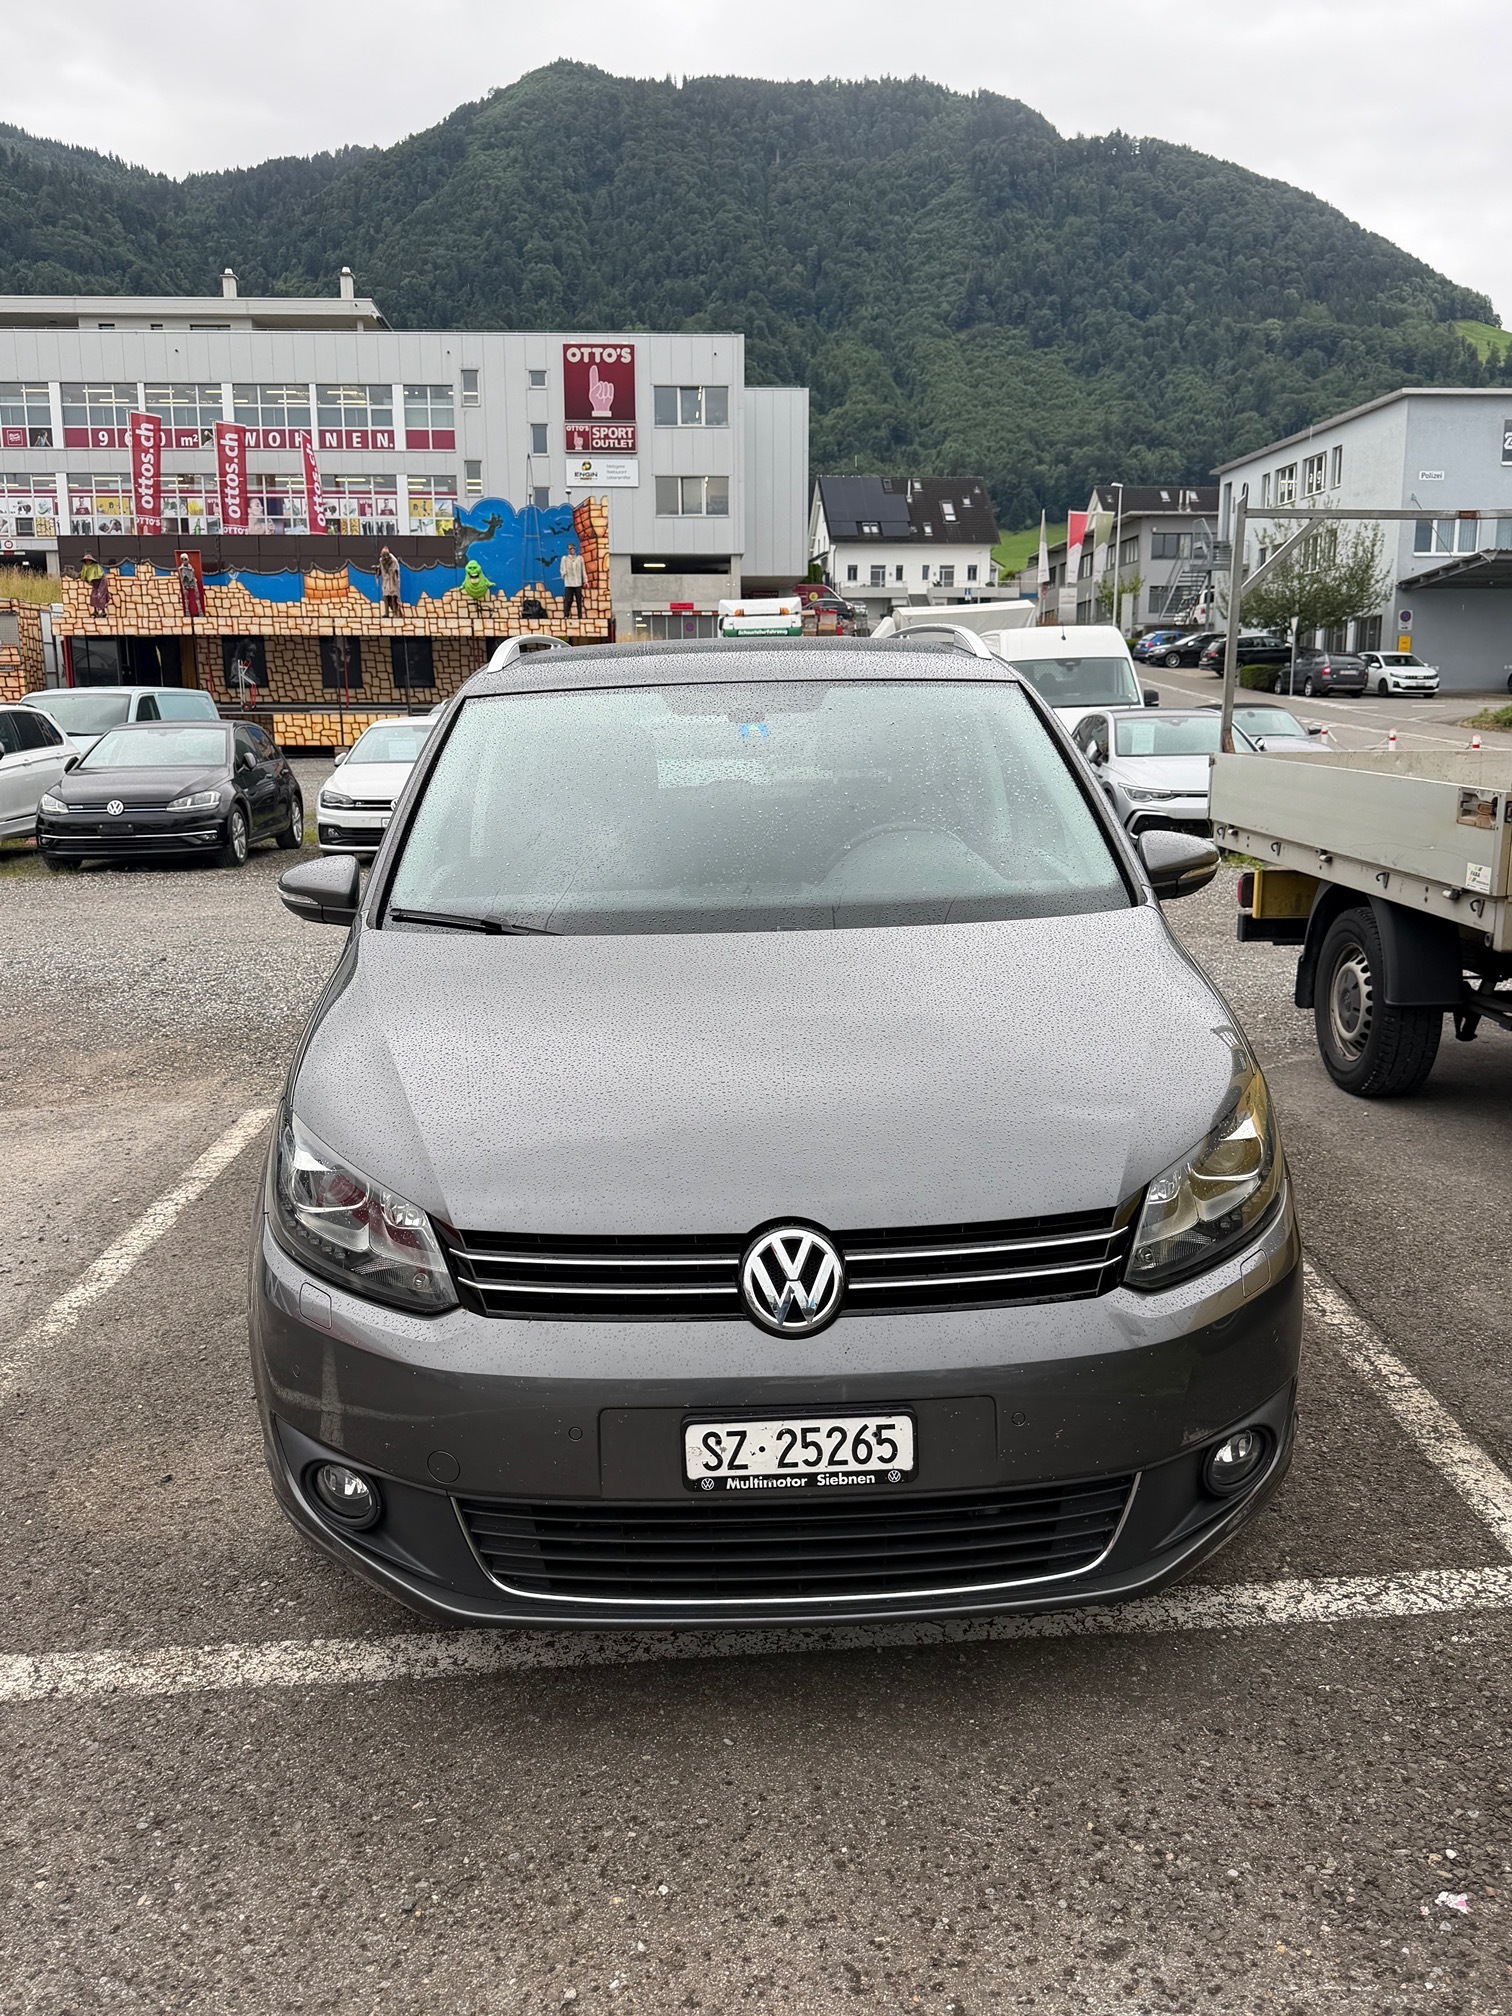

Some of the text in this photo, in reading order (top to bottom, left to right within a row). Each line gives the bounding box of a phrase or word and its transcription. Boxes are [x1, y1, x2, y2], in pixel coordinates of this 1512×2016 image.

[566, 347, 632, 363] OTTO'S
[592, 427, 634, 438] SPORT
[592, 439, 634, 448] OUTLET
[135, 422, 154, 509] ottos.ch
[220, 432, 241, 519] ottos.ch
[726, 1475, 808, 1490] Multimotor
[816, 1473, 876, 1487] Siebnen
